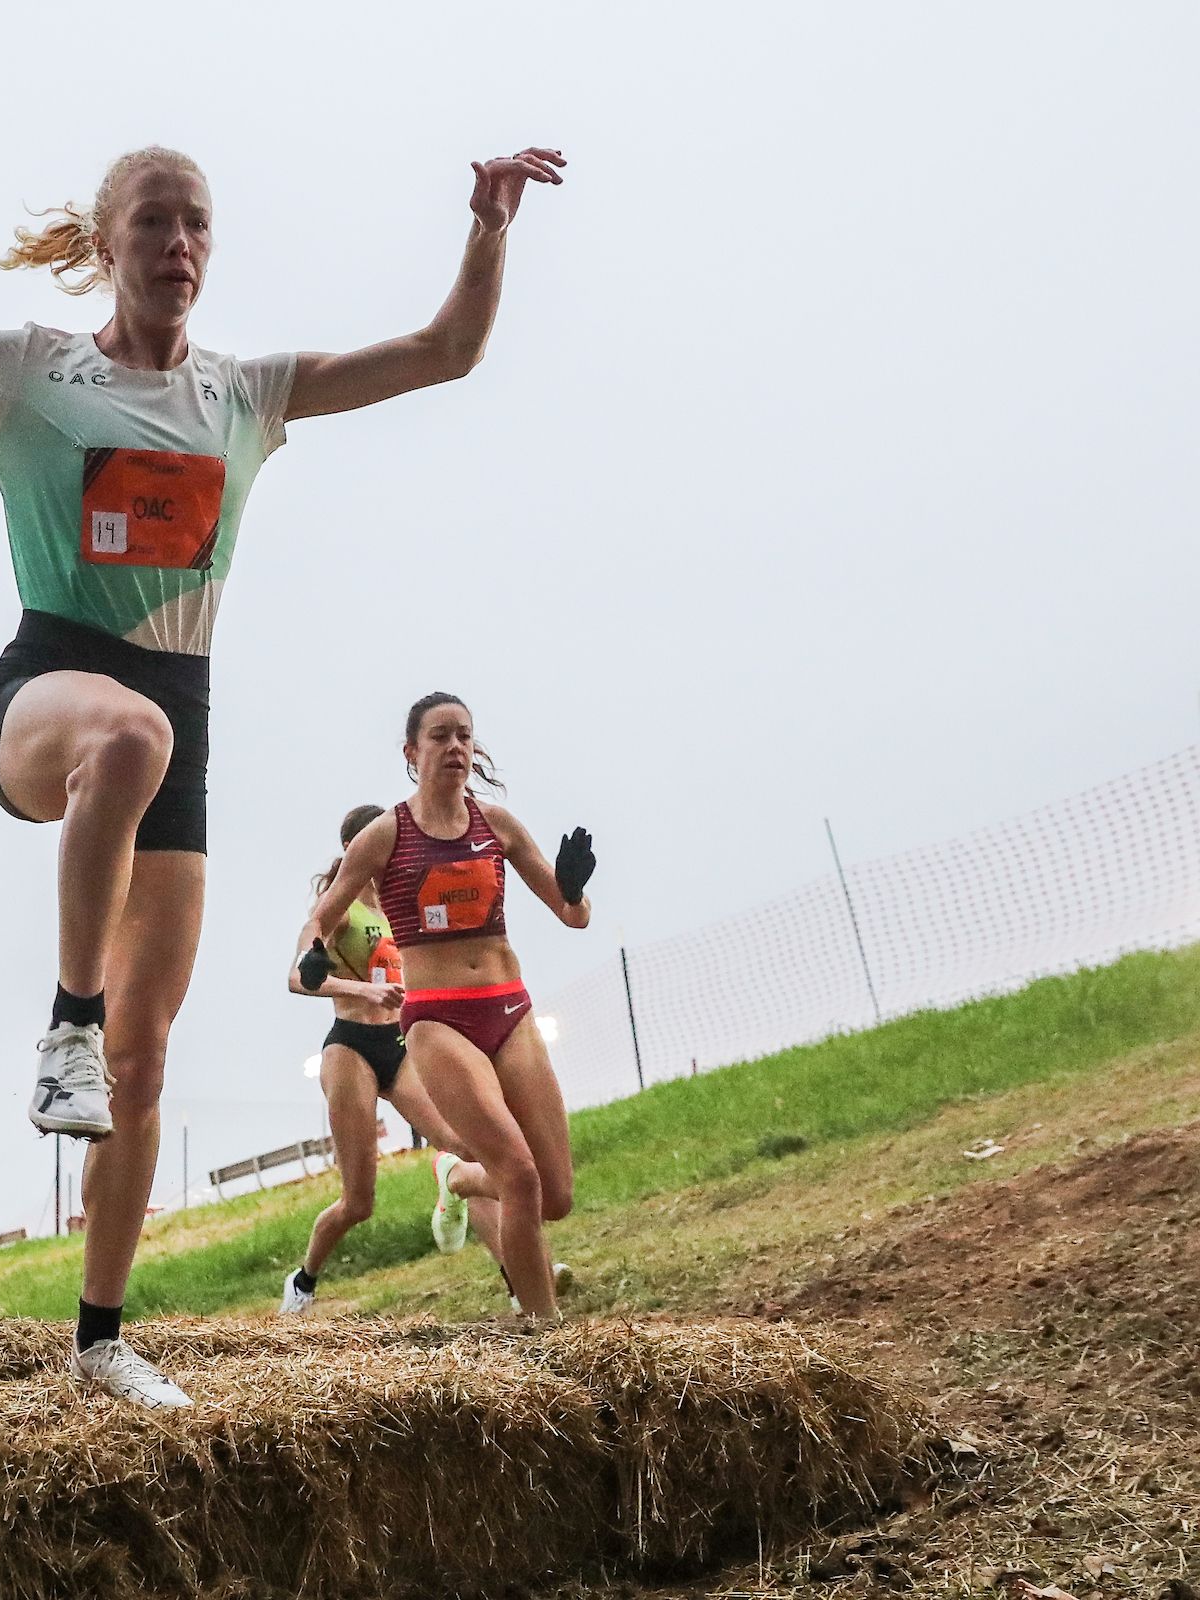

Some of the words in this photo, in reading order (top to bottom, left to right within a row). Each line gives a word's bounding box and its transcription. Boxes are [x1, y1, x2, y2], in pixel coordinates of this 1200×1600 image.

[48, 370, 106, 386] OAC
[132, 496, 175, 521] OAC
[97, 520, 115, 544] 14
[438, 887, 480, 904] INFELD
